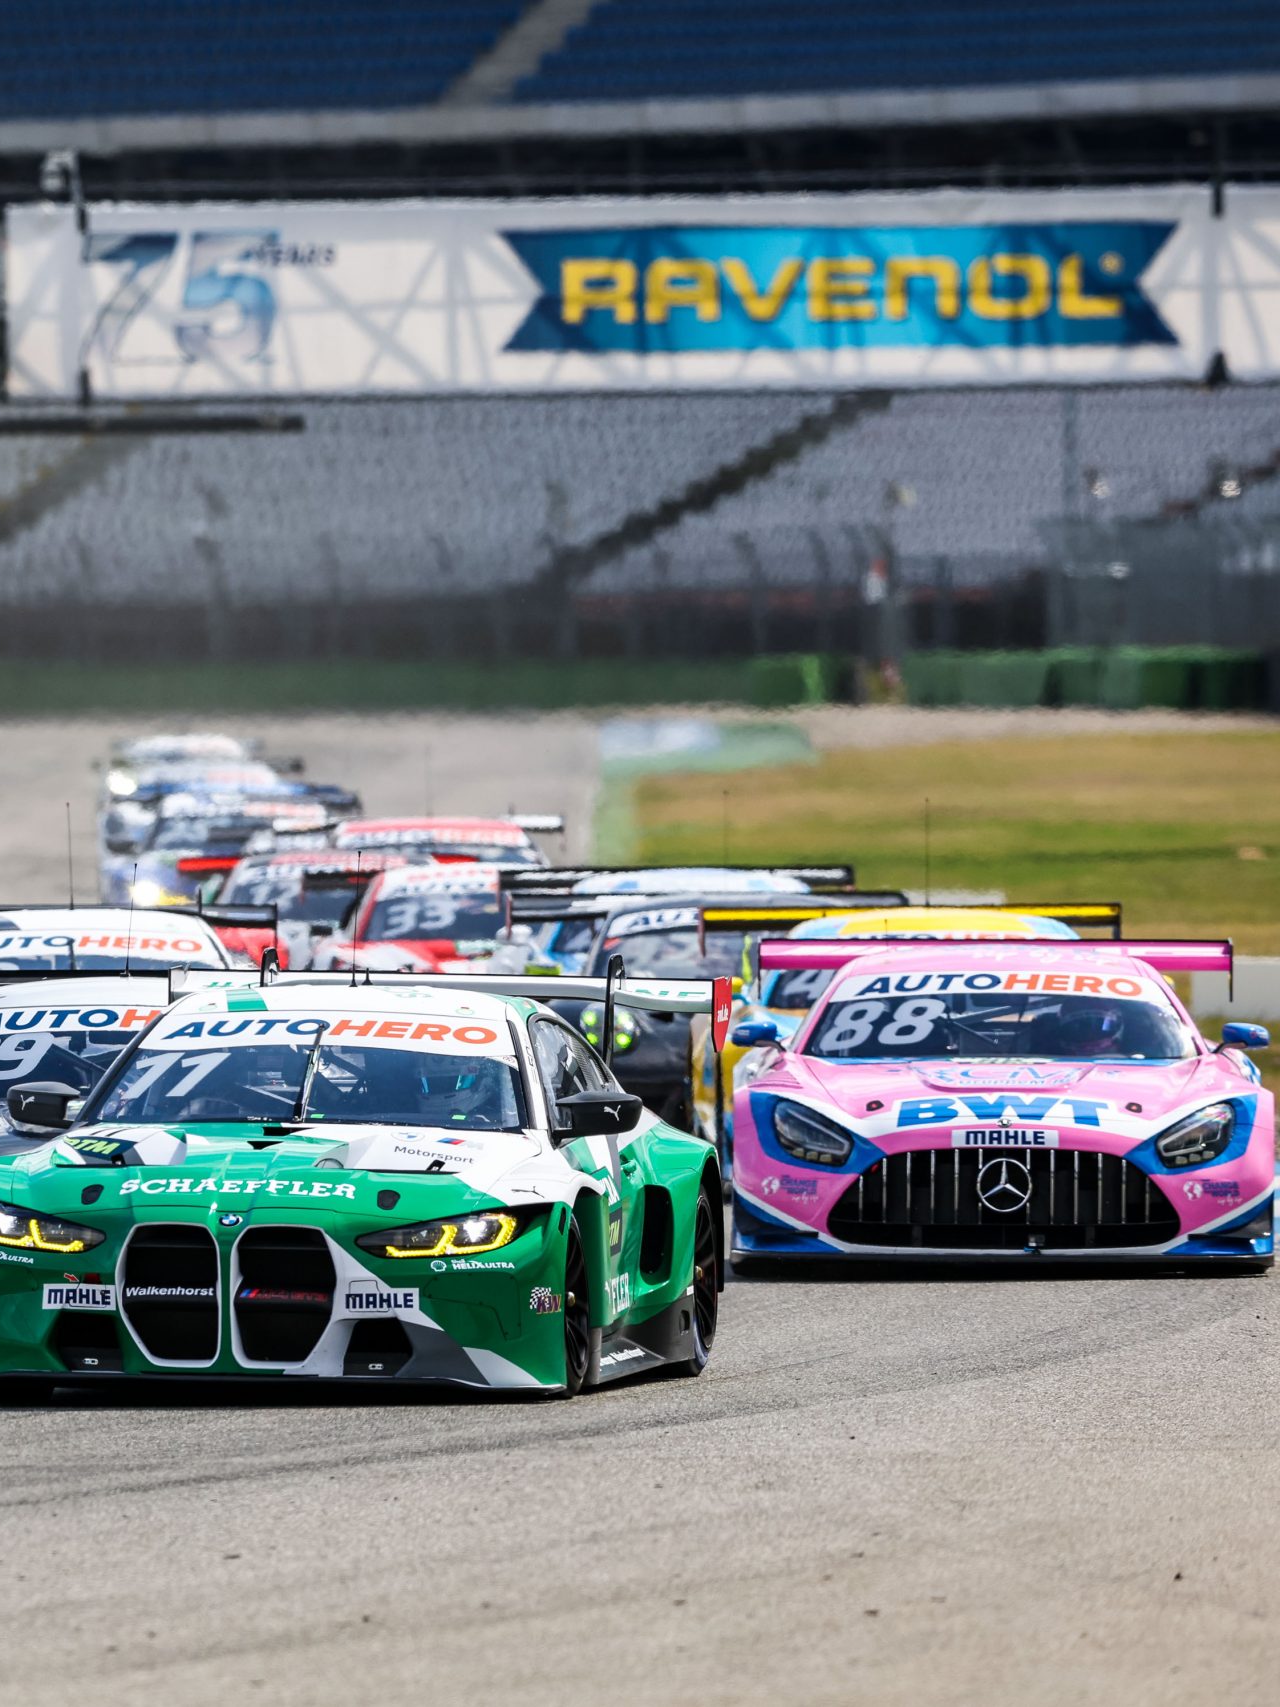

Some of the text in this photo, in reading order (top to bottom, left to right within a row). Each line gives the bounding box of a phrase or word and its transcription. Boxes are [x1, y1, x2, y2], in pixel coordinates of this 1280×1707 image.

[560, 254, 1122, 324] RAVENOL
[382, 902, 460, 938] 33
[856, 973, 1143, 998] AUTOHERO
[162, 1018, 498, 1045] AUTOHERO
[819, 998, 947, 1053] 88
[120, 1052, 232, 1100] 11
[897, 1095, 1109, 1128] BWT
[965, 1130, 1046, 1146] MAHLE
[394, 1146, 474, 1165] Motorsport
[119, 1176, 356, 1199] SCHAEFFLER
[47, 1288, 111, 1307] MAHLE
[125, 1285, 214, 1297] Walkenhorst
[345, 1292, 414, 1310] MAHLE
